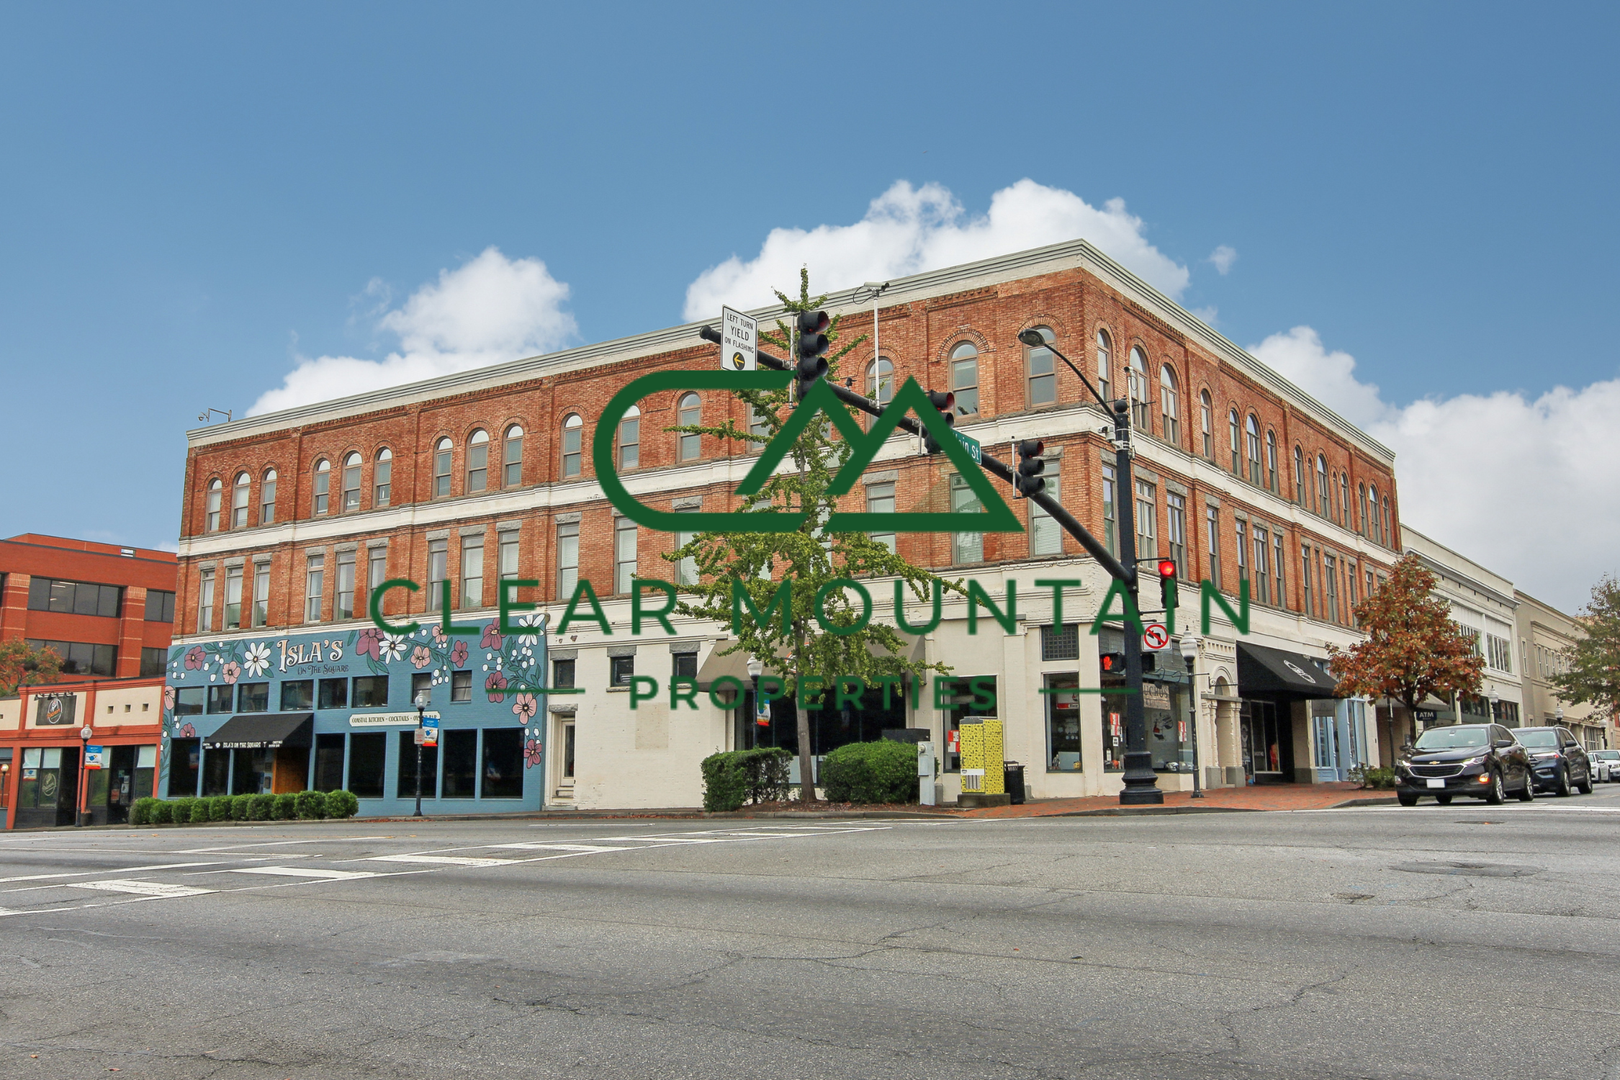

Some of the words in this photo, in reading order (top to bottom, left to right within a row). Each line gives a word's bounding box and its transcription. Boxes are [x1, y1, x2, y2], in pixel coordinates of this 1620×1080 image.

[727, 313, 738, 323] LEFT
[740, 319, 753, 330] TURN
[731, 325, 749, 341] YIELD
[733, 340, 754, 353] FLASHING
[972, 445, 979, 460] St
[277, 639, 344, 673] ISLA'S
[308, 665, 321, 676] THE
[323, 664, 349, 675] SQUARE
